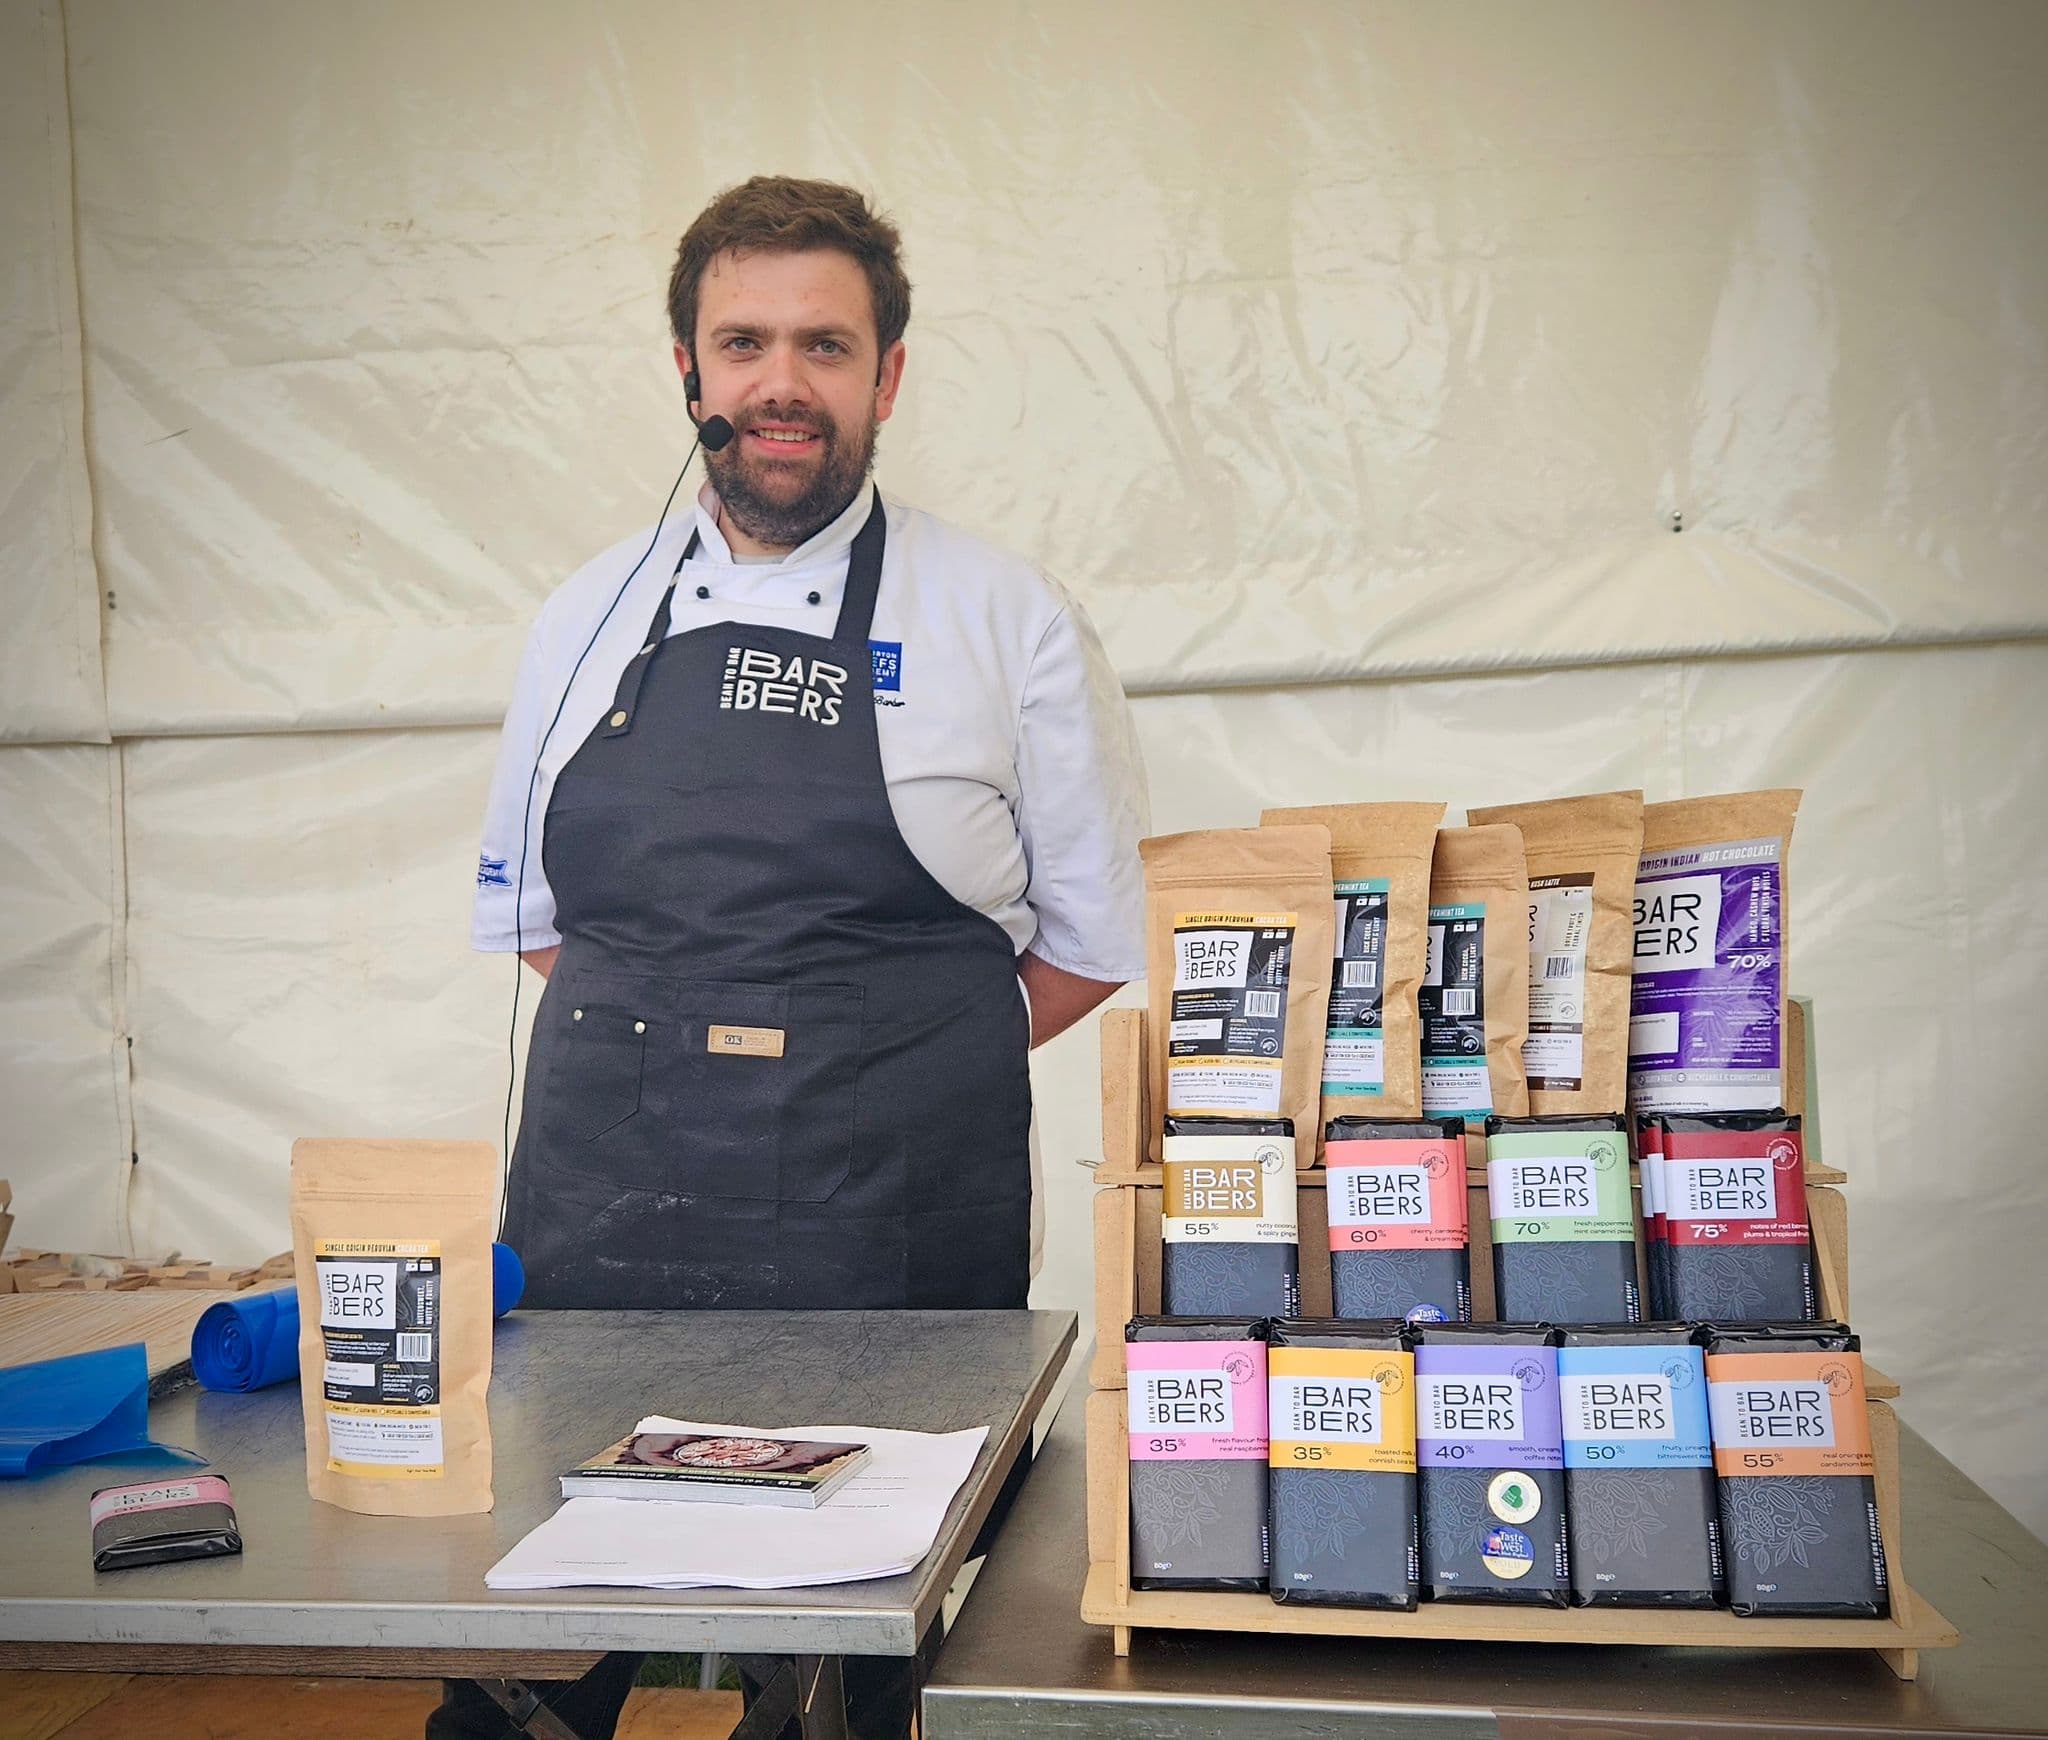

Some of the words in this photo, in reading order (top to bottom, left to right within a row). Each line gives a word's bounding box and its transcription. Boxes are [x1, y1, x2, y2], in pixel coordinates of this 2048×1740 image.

[727, 647, 742, 665] BAR
[724, 669, 737, 680] TO
[740, 648, 848, 696] BAR
[735, 679, 843, 726] BERS
[1640, 856, 1668, 871] ORIGIN
[1670, 852, 1700, 867] INDIAN
[1702, 850, 1719, 863] HOT
[1722, 844, 1775, 861] CHOCOLATE
[1225, 915, 1254, 923] PERUVIAN
[1633, 893, 1702, 926] BAR
[1190, 940, 1239, 959] BAR
[1633, 926, 1700, 958] ERS
[1190, 960, 1237, 979] BERS
[1727, 954, 1772, 969] 70%
[1192, 1168, 1256, 1188] BAR
[1357, 1174, 1420, 1194] BAR
[1521, 1166, 1587, 1186] BAR
[1699, 1167, 1765, 1187] BAR
[1192, 1190, 1257, 1210] BERS
[1358, 1195, 1423, 1216] BERS
[1523, 1187, 1590, 1208] BERS
[1700, 1190, 1767, 1210] BERS
[1185, 1222, 1219, 1235] 55%
[1351, 1229, 1387, 1243] 60%
[1515, 1221, 1550, 1235] 70%
[1689, 1223, 1728, 1238] 75%
[1771, 1231, 1797, 1239] tropical
[325, 1244, 344, 1252] SINGLE
[346, 1244, 366, 1252] ORIGIN
[367, 1244, 396, 1252] PERUVIAN
[331, 1274, 384, 1294] BAR
[333, 1296, 384, 1317] BERS
[1157, 1378, 1223, 1399] BAR
[1303, 1386, 1372, 1409] BAR
[1443, 1385, 1513, 1405] BAR
[1591, 1383, 1663, 1405] BAR
[1747, 1390, 1820, 1412] BAR
[1158, 1402, 1225, 1423] BERS
[1303, 1410, 1372, 1433] BERS
[1444, 1409, 1515, 1430] BERS
[1593, 1408, 1666, 1430] BERS
[1750, 1415, 1825, 1437] BERS
[1150, 1438, 1186, 1452] 35%
[1293, 1446, 1332, 1460] 35%
[1435, 1445, 1475, 1459] 40%
[1586, 1445, 1626, 1460] 50%
[1743, 1452, 1784, 1467] 55%
[1499, 1531, 1524, 1543] Taste
[1500, 1542, 1524, 1553] West
[1710, 1541, 1718, 1575] PERUVIAN
